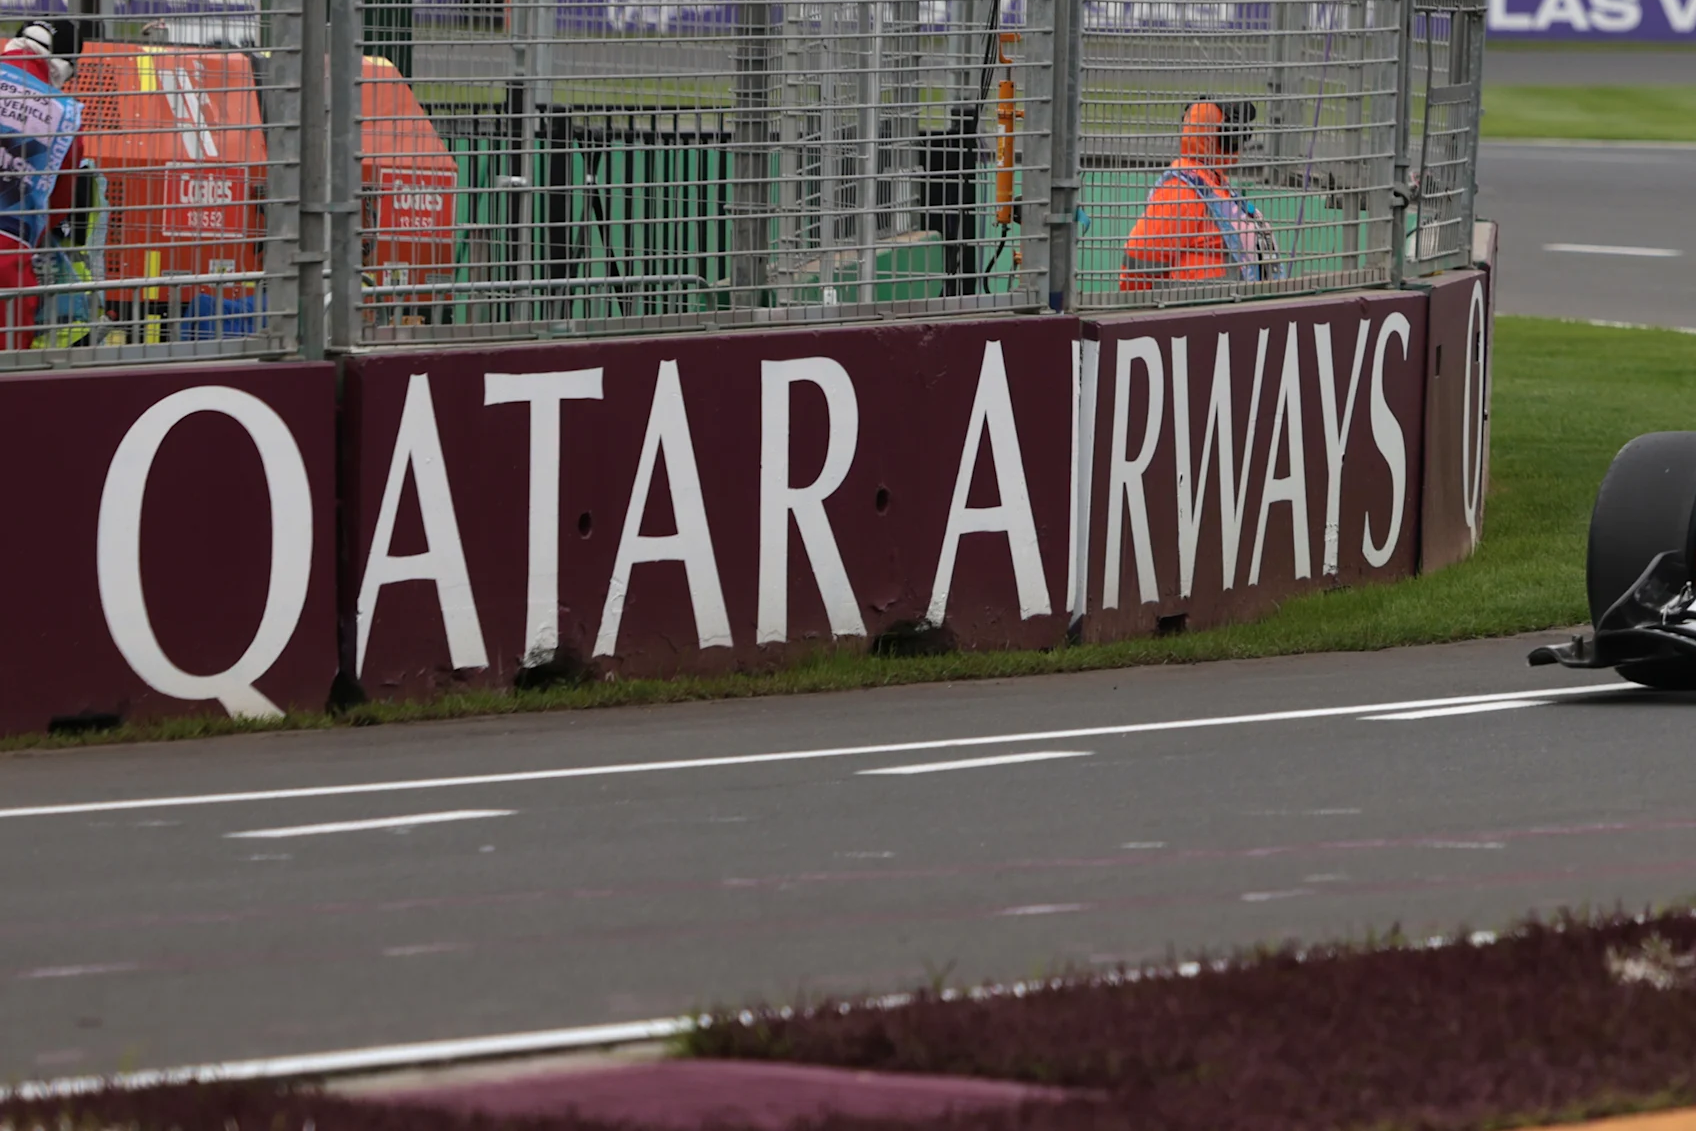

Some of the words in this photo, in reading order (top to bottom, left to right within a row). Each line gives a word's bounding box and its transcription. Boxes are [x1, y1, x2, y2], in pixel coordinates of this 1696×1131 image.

[4, 98, 52, 125] VEHICLE
[180, 173, 232, 204] Coates
[96, 356, 867, 720] QATAR
[924, 311, 1412, 630] AIRWAYS
